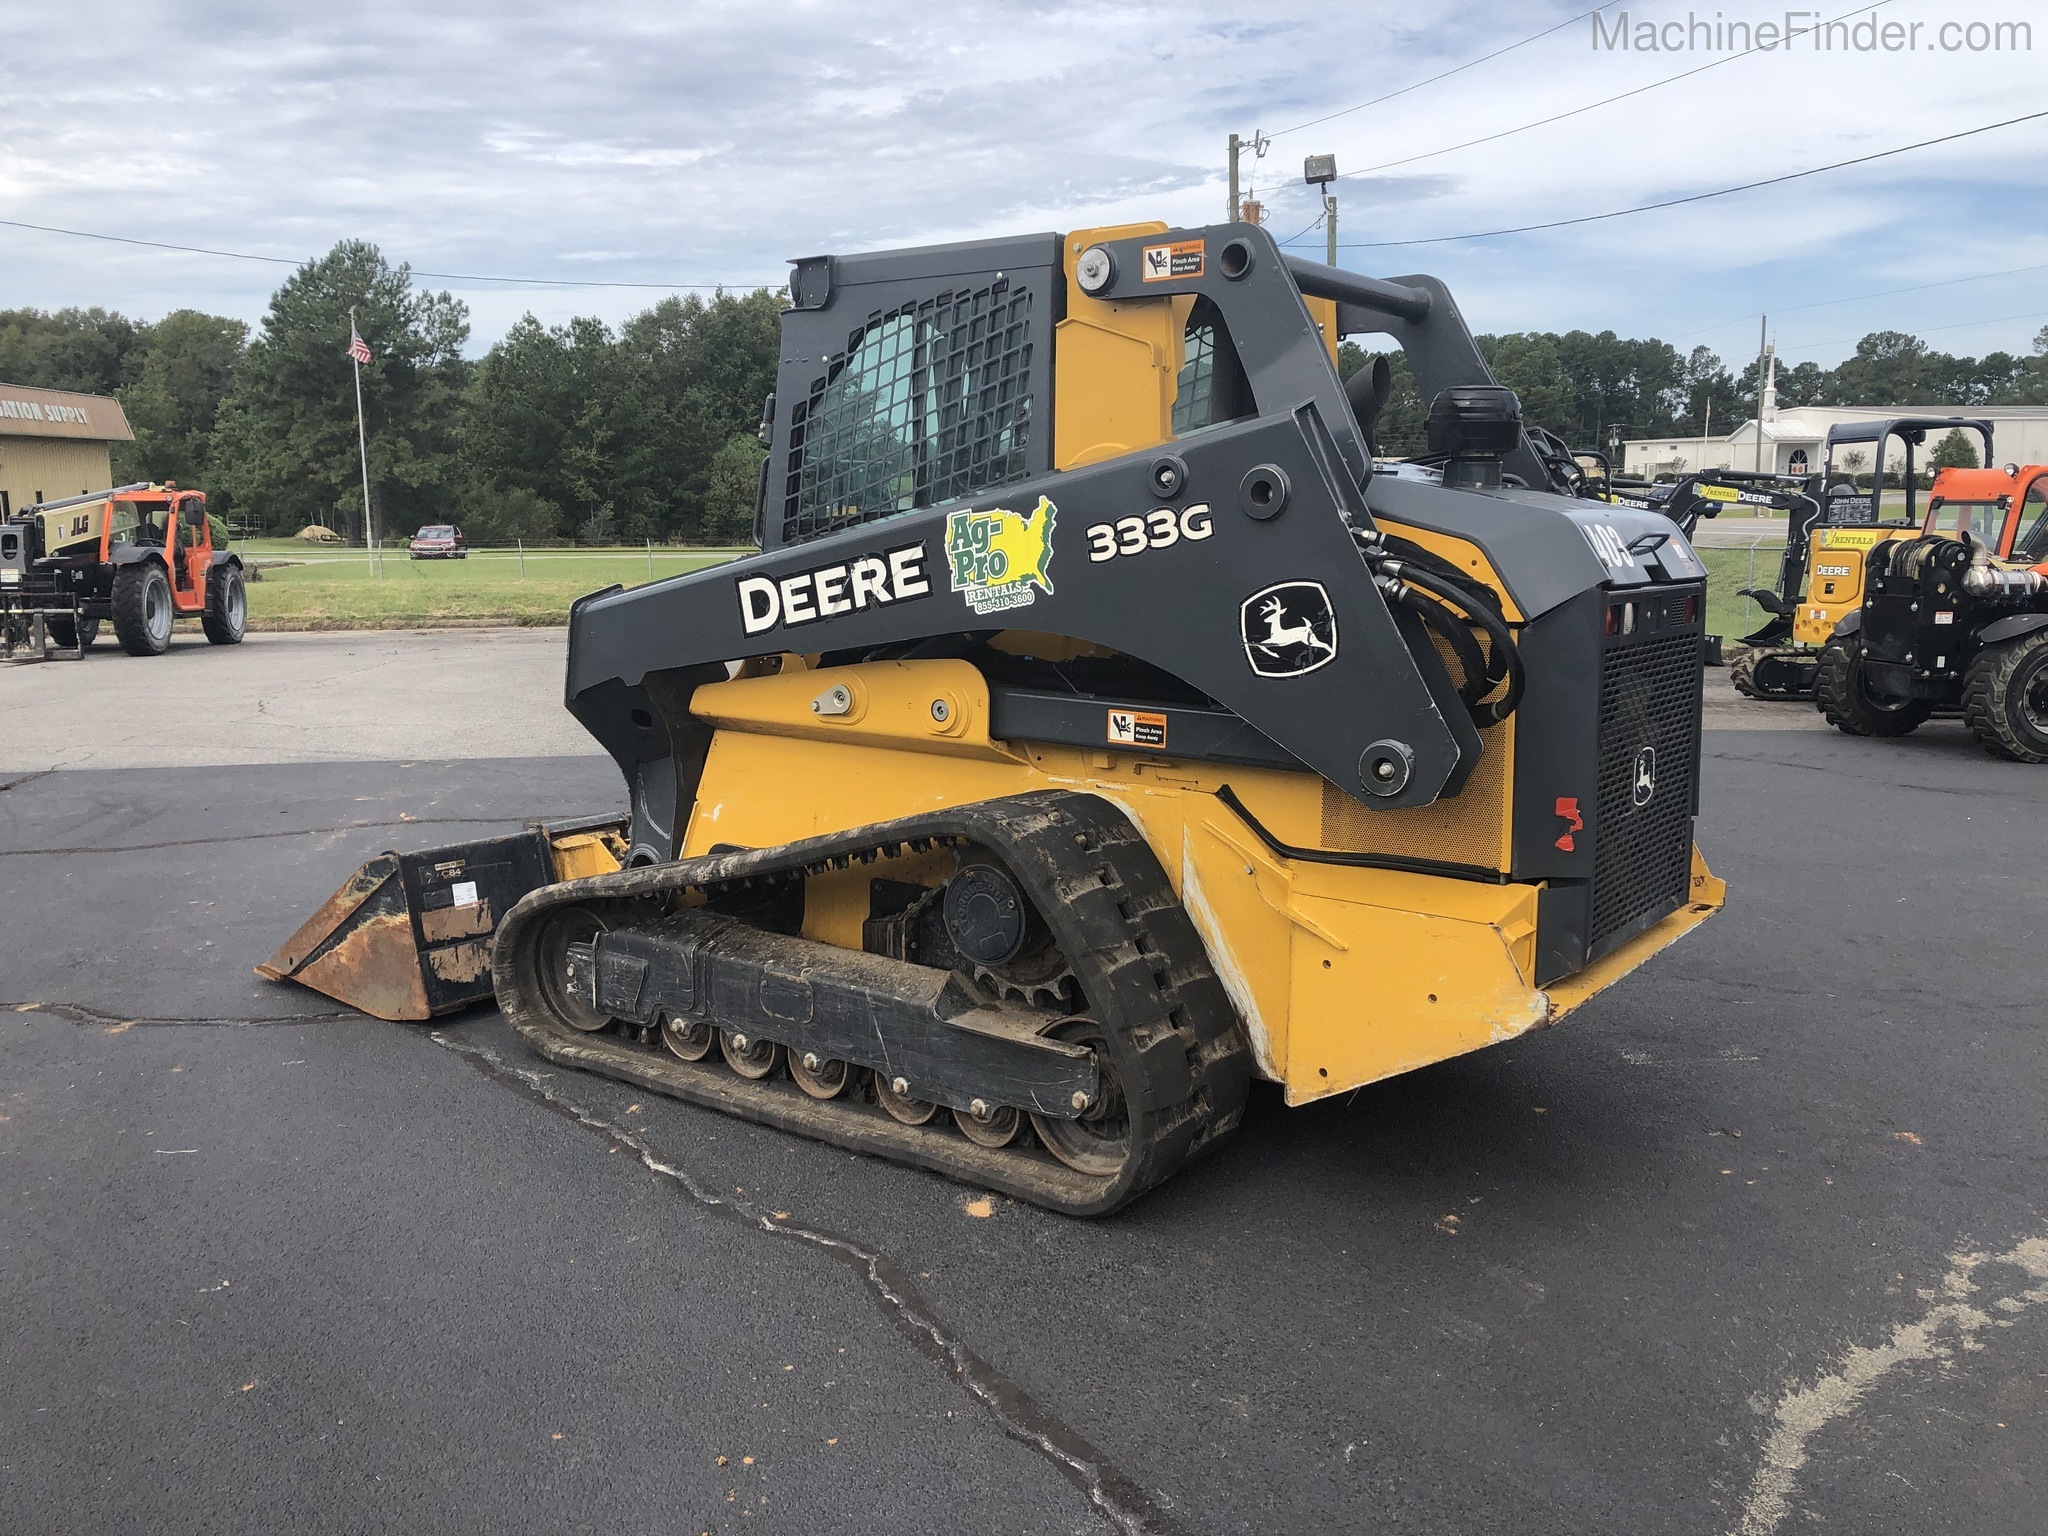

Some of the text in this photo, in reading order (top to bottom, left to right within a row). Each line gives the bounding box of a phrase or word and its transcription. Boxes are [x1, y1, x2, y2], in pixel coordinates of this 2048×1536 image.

[1172, 257, 1187, 265] Pinch
[0, 400, 88, 424] ATION SUPPLY
[1617, 497, 1649, 509] DEERE
[1709, 489, 1737, 498] RENTALS
[1738, 491, 1773, 504] DEERE
[71, 515, 90, 537] JLG
[950, 514, 1003, 554] Ag-
[1086, 502, 1215, 562] 333G
[1583, 523, 1635, 568] 403
[1834, 537, 1874, 545] RENTALS
[953, 549, 1007, 587] Pro
[1817, 564, 1850, 576] DEERE
[737, 543, 931, 636] DEERE
[968, 581, 1022, 603] RENTALS
[977, 592, 1034, 612] 855-310-3600
[1135, 726, 1163, 735] Pinch Area
